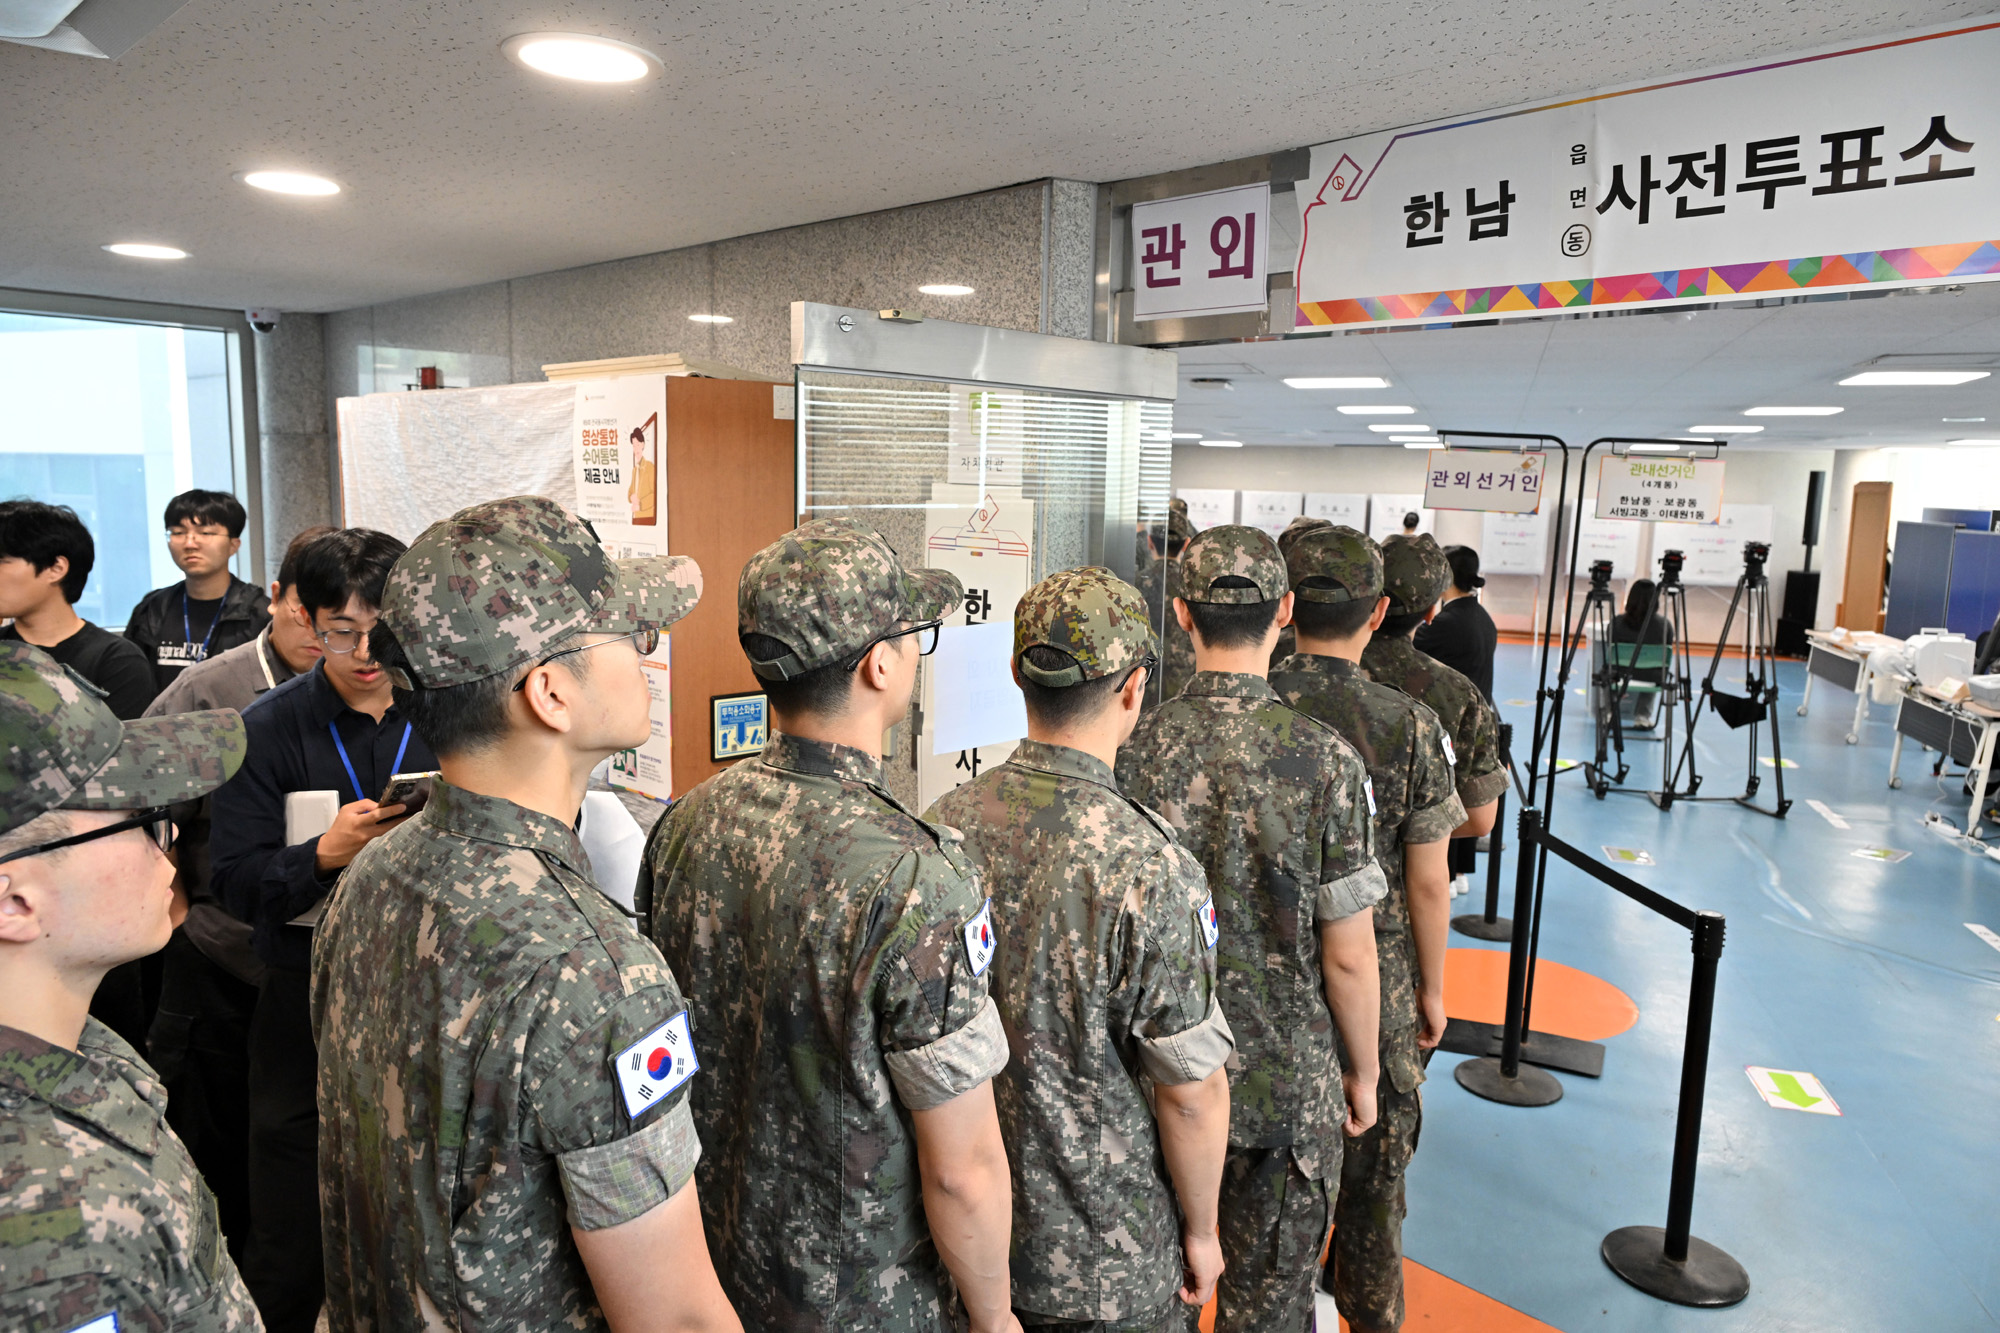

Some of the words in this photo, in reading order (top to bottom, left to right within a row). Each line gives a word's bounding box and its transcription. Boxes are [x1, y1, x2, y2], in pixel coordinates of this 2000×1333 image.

[1595, 115, 1976, 225] 사전투표소
[582, 428, 619, 446] 영상통화
[582, 448, 619, 465] 수어통역
[583, 468, 601, 484] 제공
[602, 468, 621, 485] 안내
[1629, 462, 1697, 479] 관내선거인
